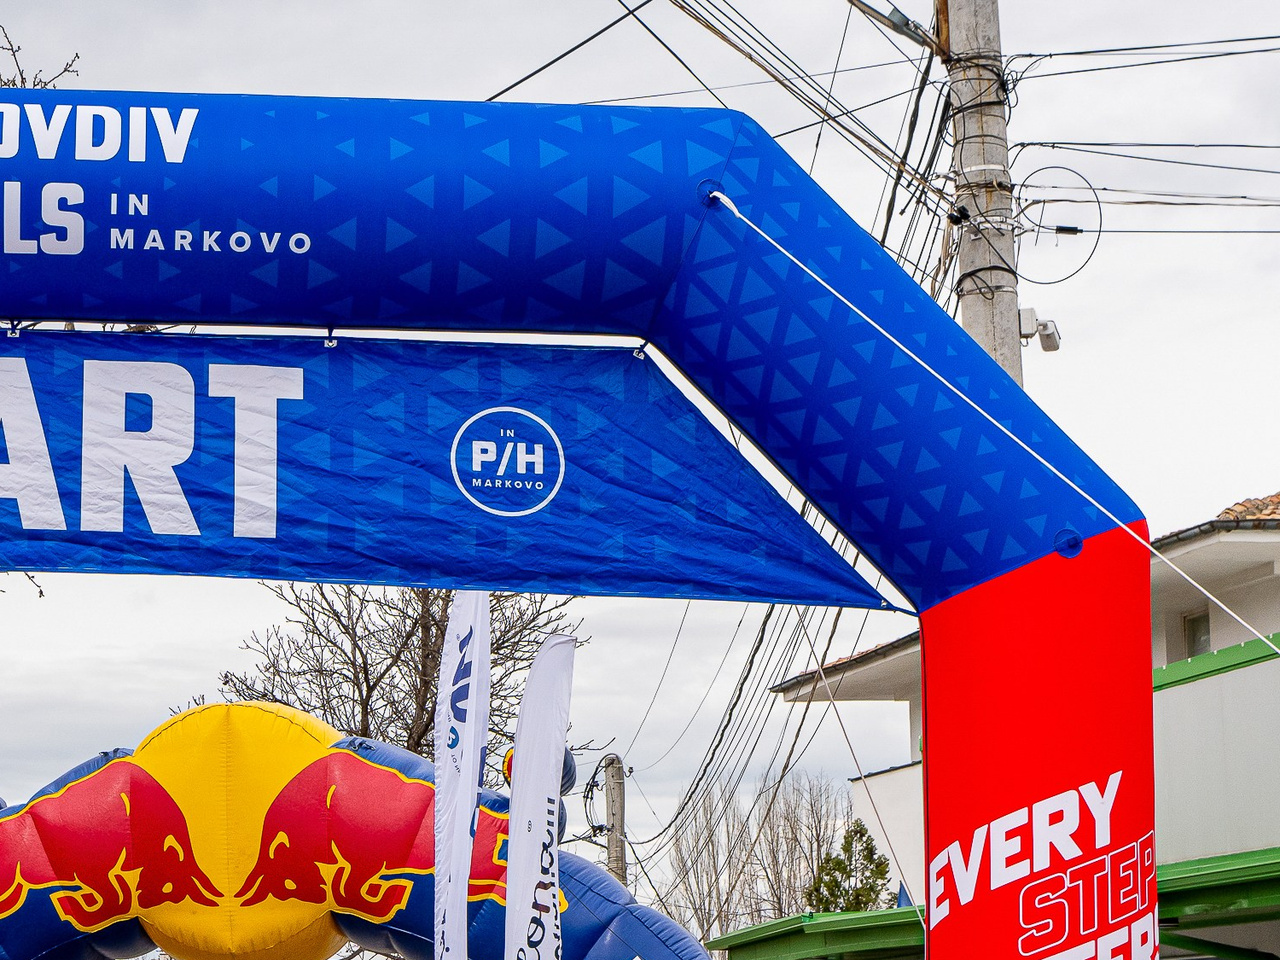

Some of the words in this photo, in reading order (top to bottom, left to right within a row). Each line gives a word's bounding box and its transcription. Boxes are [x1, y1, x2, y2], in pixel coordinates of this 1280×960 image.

[110, 193, 150, 216] IN
[110, 228, 312, 256] MARKOVO
[500, 428, 515, 438] IN
[471, 440, 544, 476] P/H
[472, 478, 544, 490] MARKOVO
[929, 770, 1123, 931] EVERY
[1018, 830, 1156, 957] STEP
